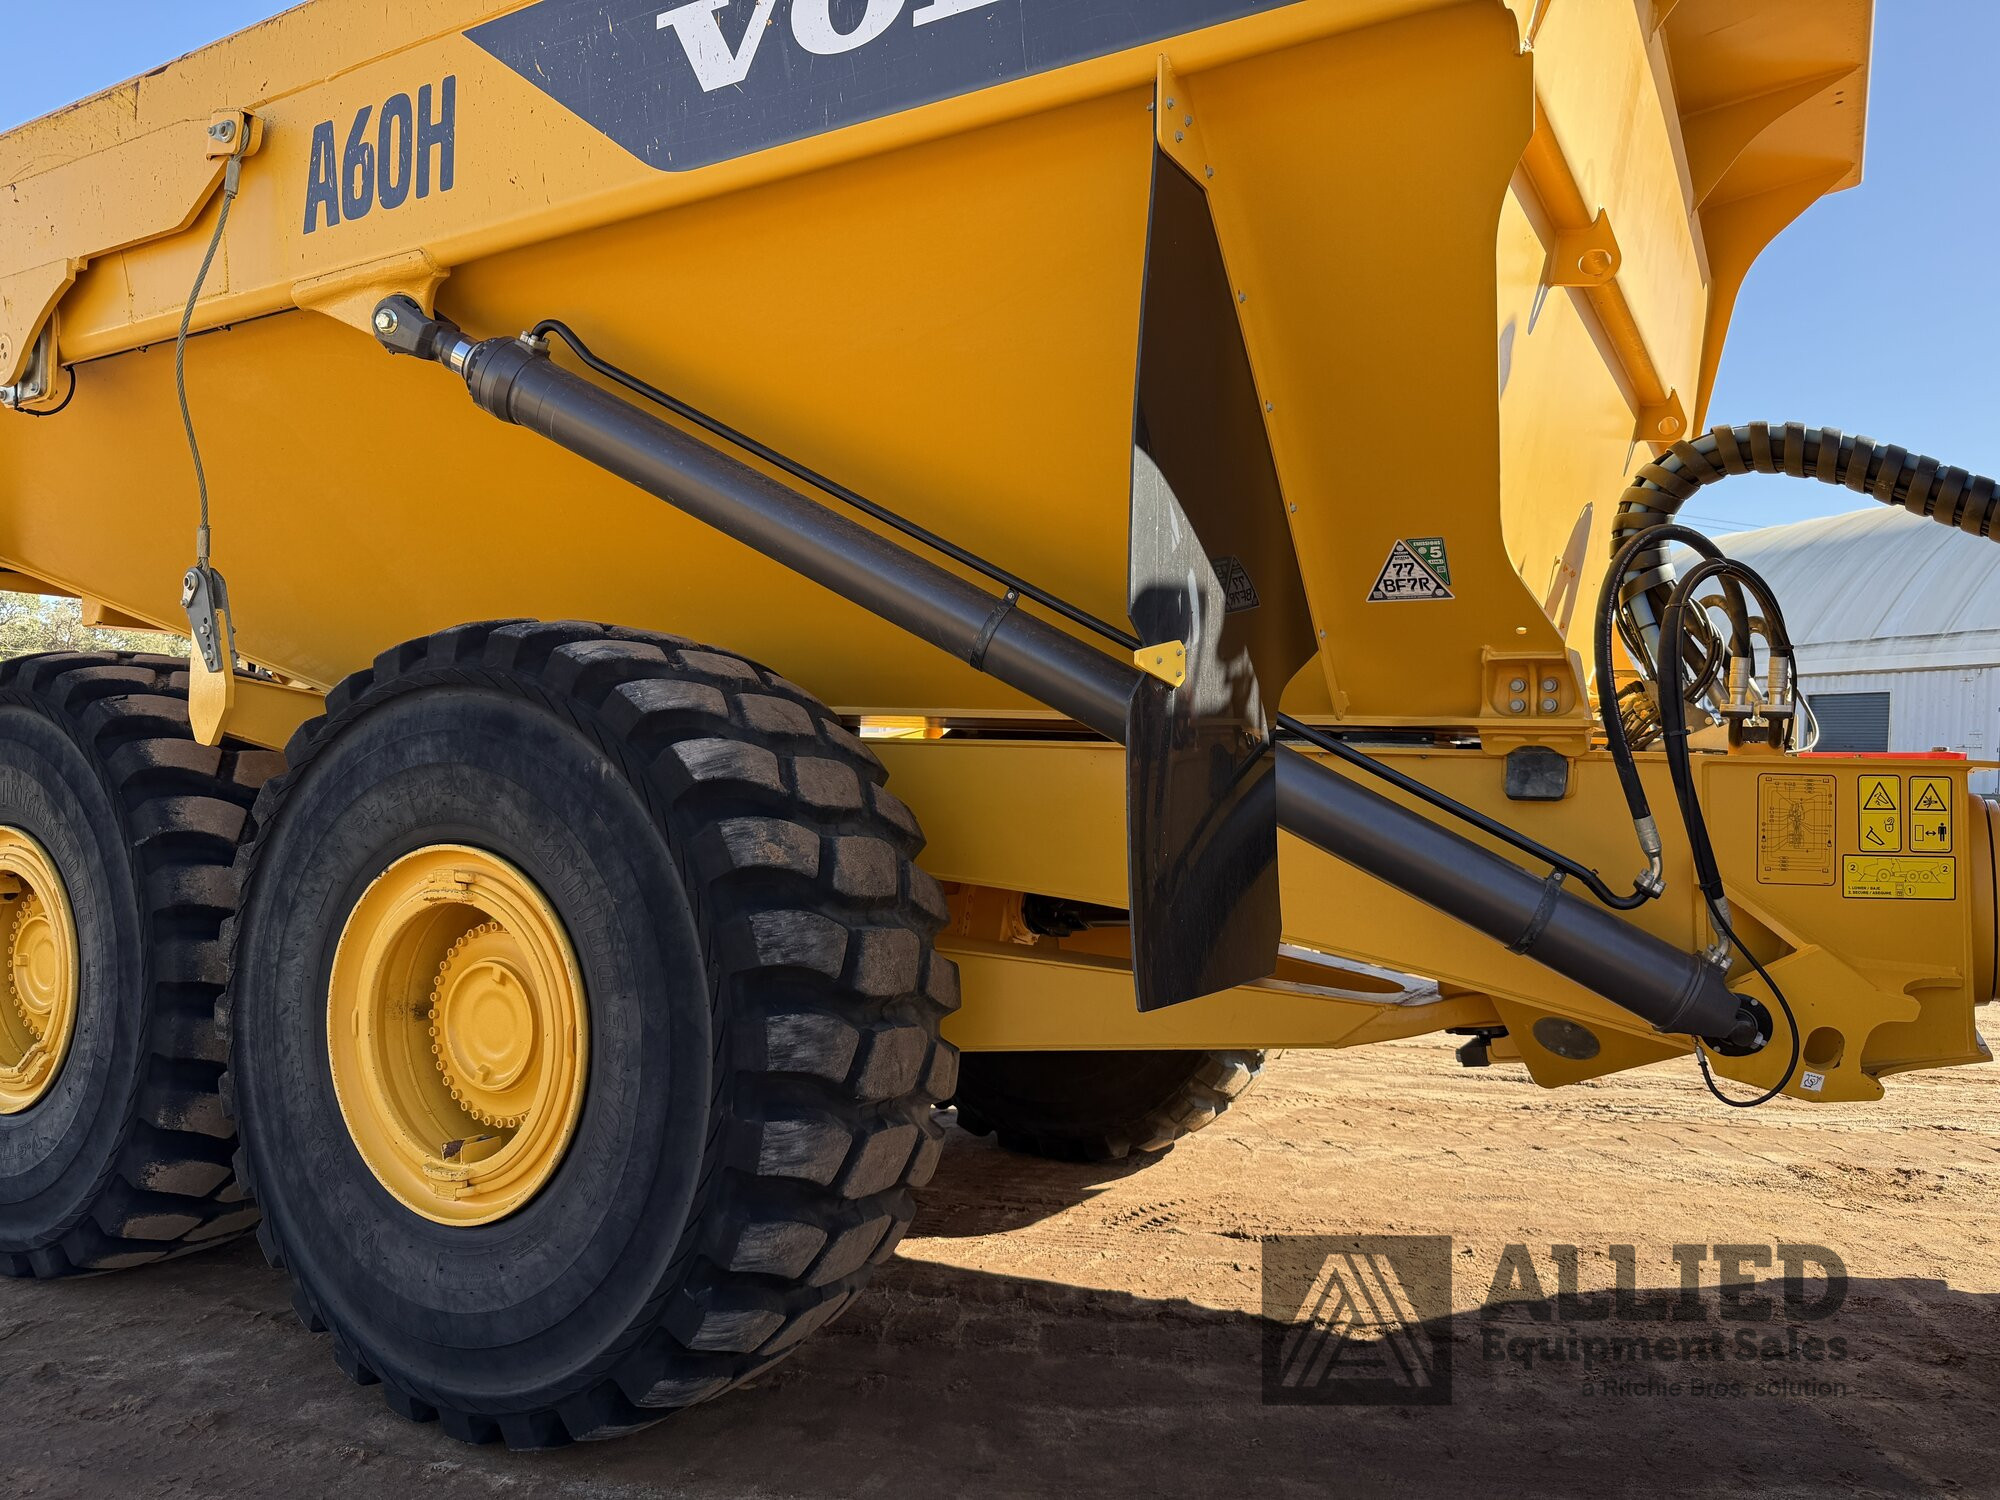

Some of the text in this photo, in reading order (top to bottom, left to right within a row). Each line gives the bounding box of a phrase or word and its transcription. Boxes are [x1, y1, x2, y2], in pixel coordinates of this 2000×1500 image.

[303, 75, 456, 234] A60H
[1430, 546, 1442, 559] 5
[1392, 563, 1414, 577] 77
[1383, 577, 1431, 592] BF7R
[531, 832, 629, 1208] BRIDGESTONE
